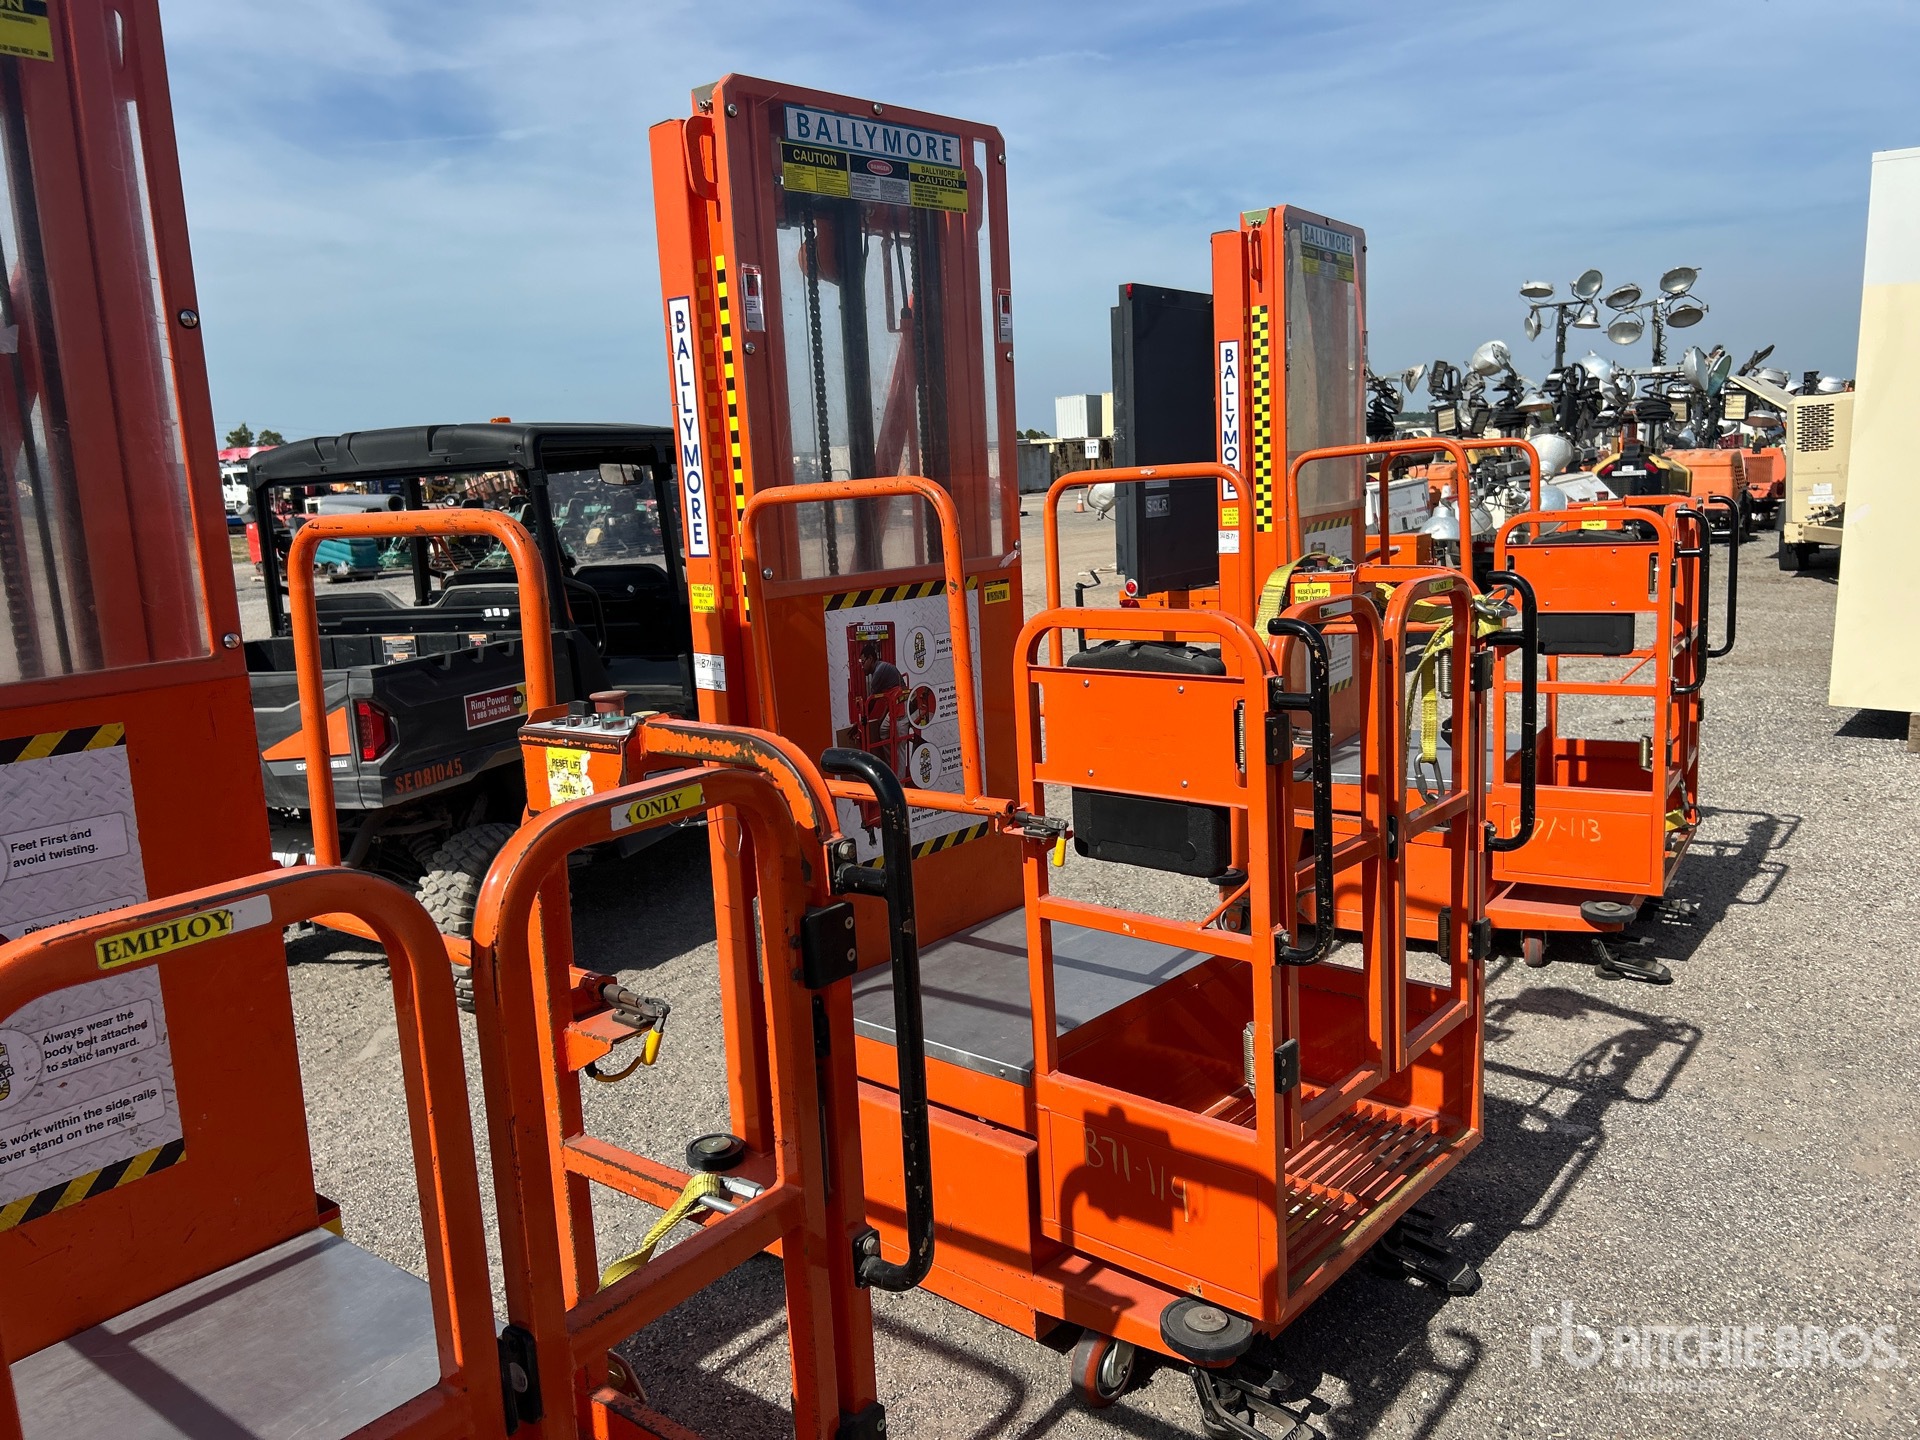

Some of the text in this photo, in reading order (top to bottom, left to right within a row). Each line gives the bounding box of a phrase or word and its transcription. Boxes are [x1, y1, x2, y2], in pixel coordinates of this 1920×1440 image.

[797, 112, 952, 163] BALLYMORE
[793, 149, 837, 166] CAUTION
[870, 163, 890, 171] DANGER
[918, 175, 960, 188] CAUTION
[921, 166, 956, 177] BALLYMORE
[1304, 225, 1351, 252] BALLYMORE
[675, 309, 706, 545] BALLYMORE
[936, 638, 946, 646] Feet
[936, 646, 949, 654] avoid
[470, 695, 507, 710] Ring Power
[513, 695, 522, 705] CAT
[476, 711, 487, 720] 888
[488, 705, 511, 717] 748-7464
[940, 710, 951, 718] when
[941, 747, 957, 755] Always
[942, 756, 953, 764] body
[552, 758, 581, 771] RESET LIFT
[947, 763, 959, 771] static
[394, 757, 463, 795] SE081045
[636, 793, 683, 820] ONLY
[911, 815, 921, 823] and
[921, 812, 934, 820] never
[1510, 816, 1602, 843] B71-113
[10, 828, 92, 853] Feet First and
[13, 843, 99, 868] avoid twisting.
[99, 911, 232, 965] EMPLOY
[42, 1009, 134, 1046] Always wear the
[44, 1020, 148, 1060] body belt attached
[47, 1037, 140, 1073] to static lanyard.
[10, 1129, 41, 1145] work
[44, 1115, 81, 1134] within
[83, 1107, 103, 1120] the
[105, 1098, 130, 1113] side
[133, 1087, 157, 1103] rails
[0, 1111, 136, 1165] ever stand on the rails.
[1083, 1126, 1189, 1223] B71-119
